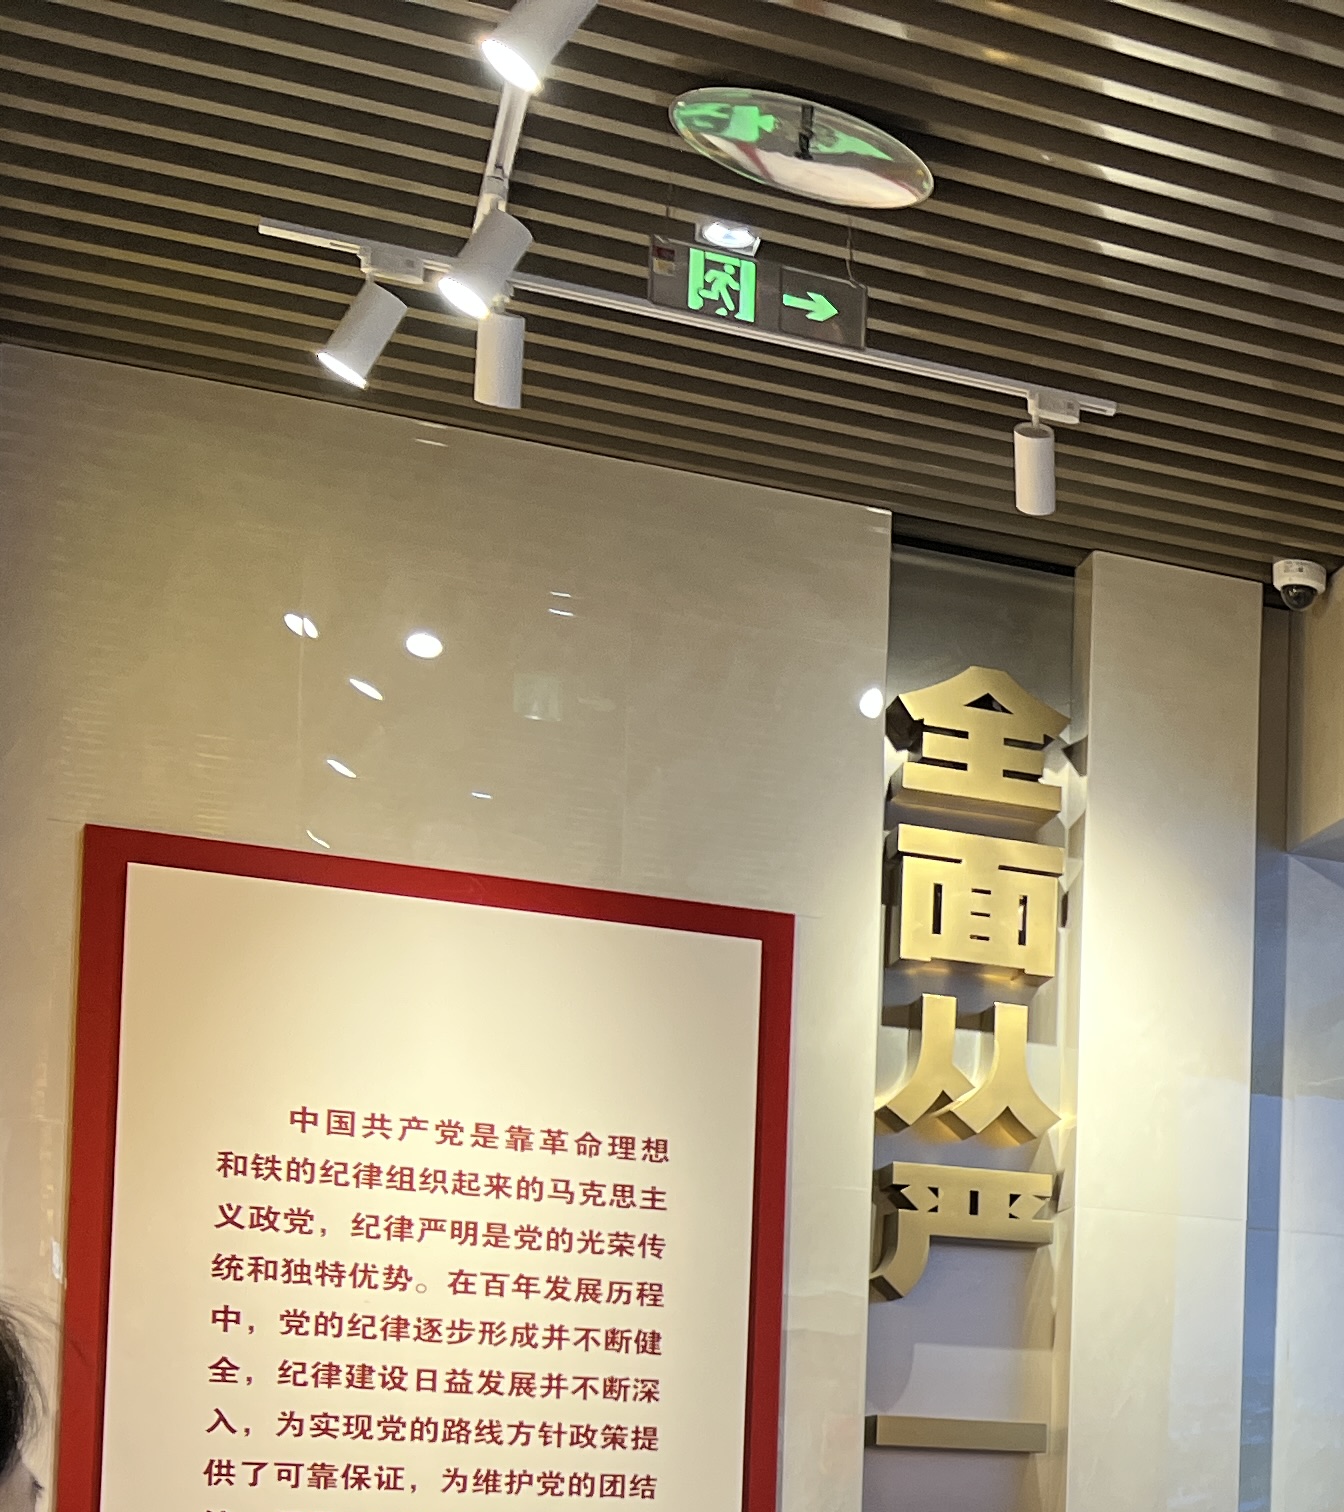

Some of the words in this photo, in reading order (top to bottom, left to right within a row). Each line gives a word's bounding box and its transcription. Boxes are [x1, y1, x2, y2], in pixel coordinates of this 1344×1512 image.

[290, 1106, 669, 1164] 中国共产党是靠革命理想
[216, 1151, 667, 1211] 和铁的纪律组织起来的马克思主
[214, 1202, 666, 1260] 义政党，纪律严明是党的光荣传
[211, 1253, 664, 1308] 统和独特优势。在百年发展历程
[211, 1304, 662, 1356] 中，党的纪律逐步形成并不断健
[208, 1356, 660, 1403] 全，纪律建设日益发展并不断深
[206, 1407, 658, 1451] 入，为实现党的路线方针政策提
[203, 1459, 657, 1500] 供了可靠保证，为维护党的团结
